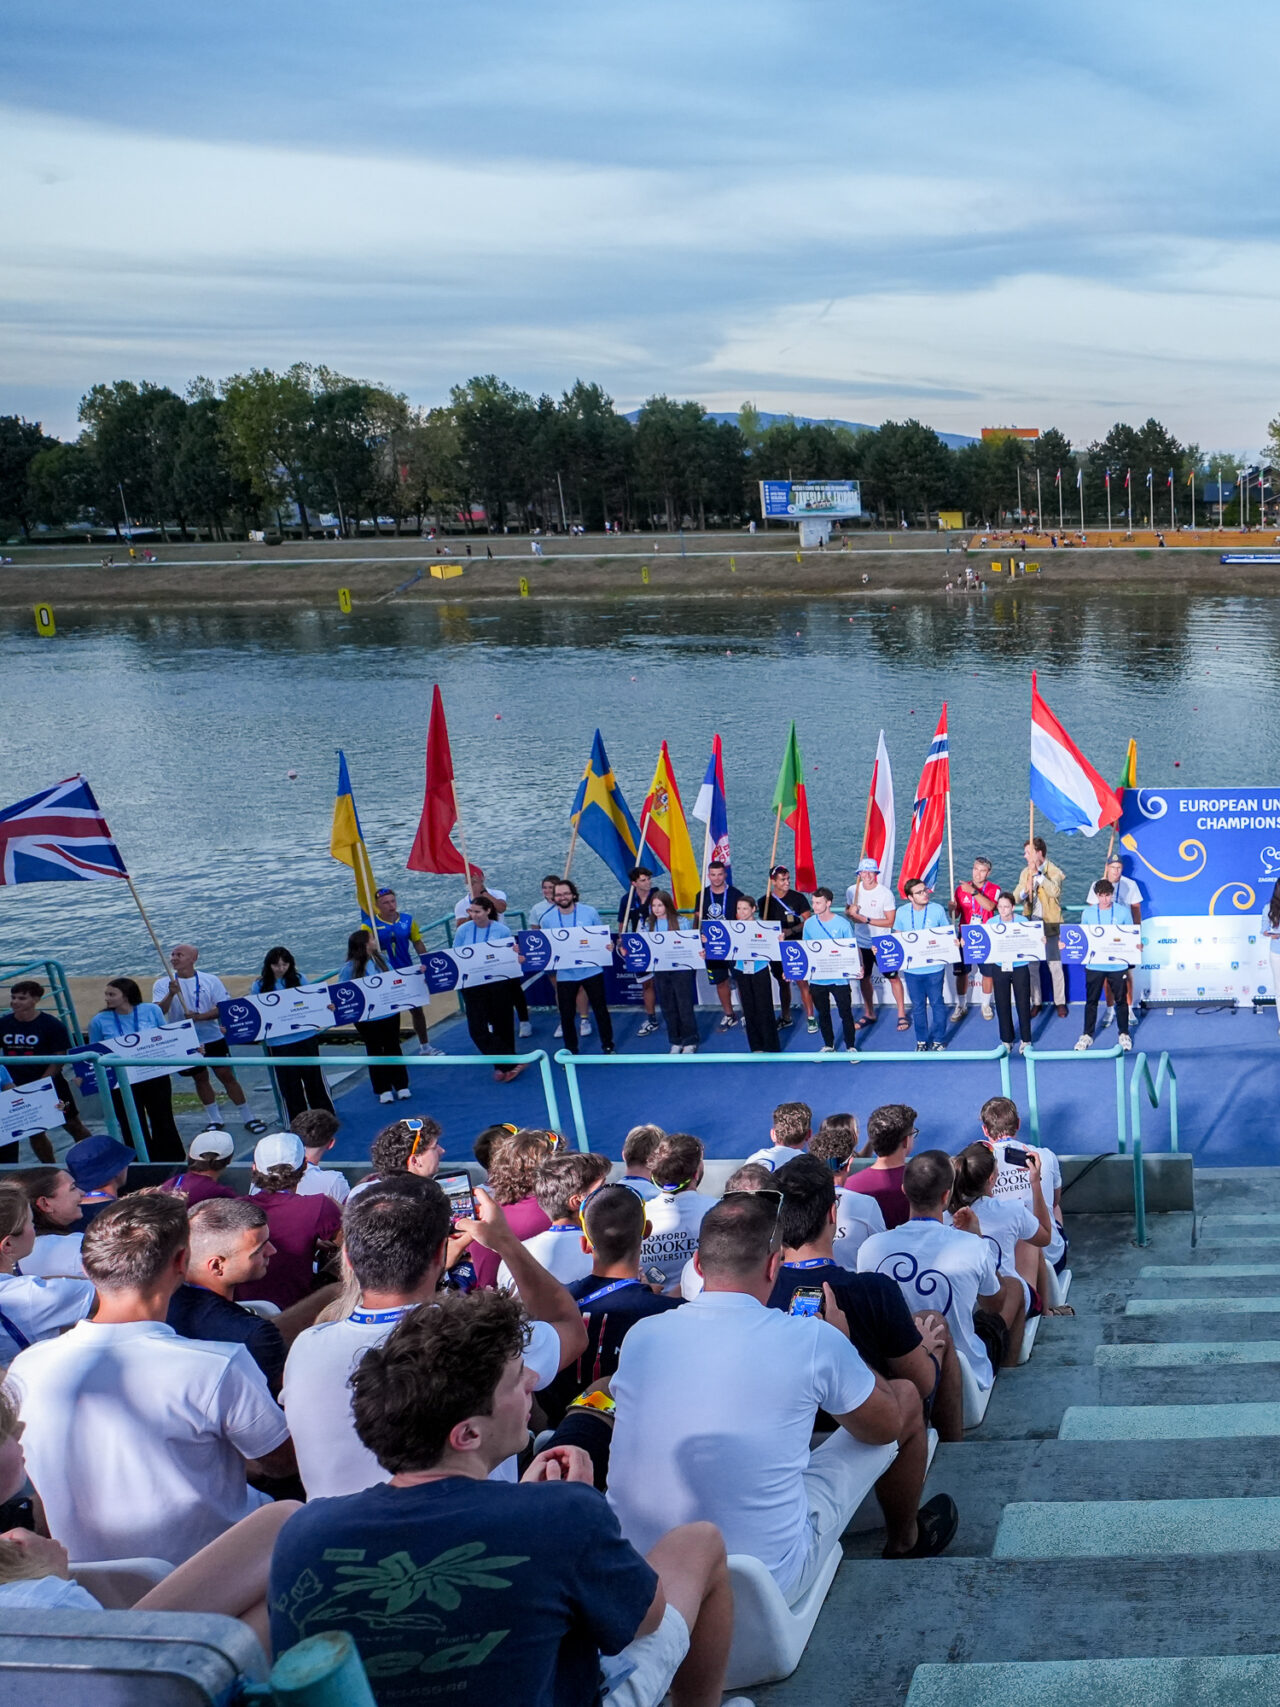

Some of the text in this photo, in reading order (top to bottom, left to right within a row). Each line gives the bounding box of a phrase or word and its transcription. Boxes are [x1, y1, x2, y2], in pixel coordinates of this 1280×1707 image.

[39, 607, 50, 627] 0
[1179, 798, 1258, 812] EUROPEAN
[3, 1033, 39, 1046] CRO
[991, 1183, 1031, 1195] NIVERSIT
[647, 1231, 688, 1243] OXFORD
[641, 1238, 700, 1255] ROOKE
[642, 1251, 694, 1263] UNIVERSITY
